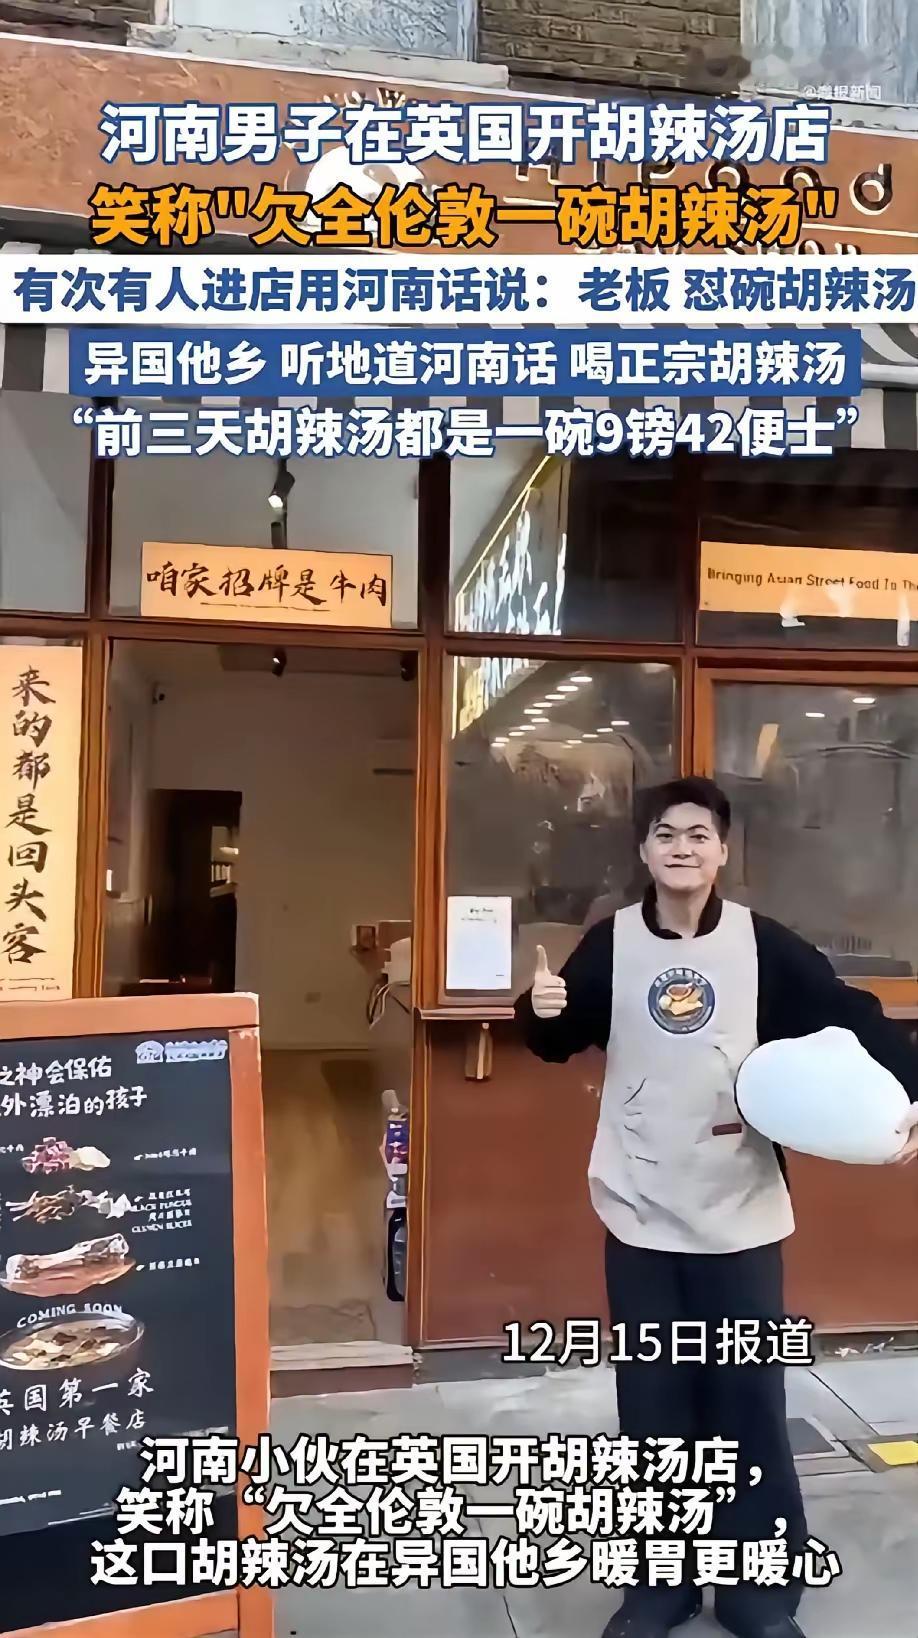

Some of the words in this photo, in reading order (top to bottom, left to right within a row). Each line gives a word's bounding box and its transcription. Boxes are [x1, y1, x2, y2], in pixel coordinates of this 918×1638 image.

[146, 560, 388, 607] 咱家招牌是牛肉
[902, 579, 918, 592] Th
[3, 664, 56, 964] 来的都是回头客
[0, 1055, 112, 1086] 之神会保佑
[16, 1303, 76, 1329] COMING
